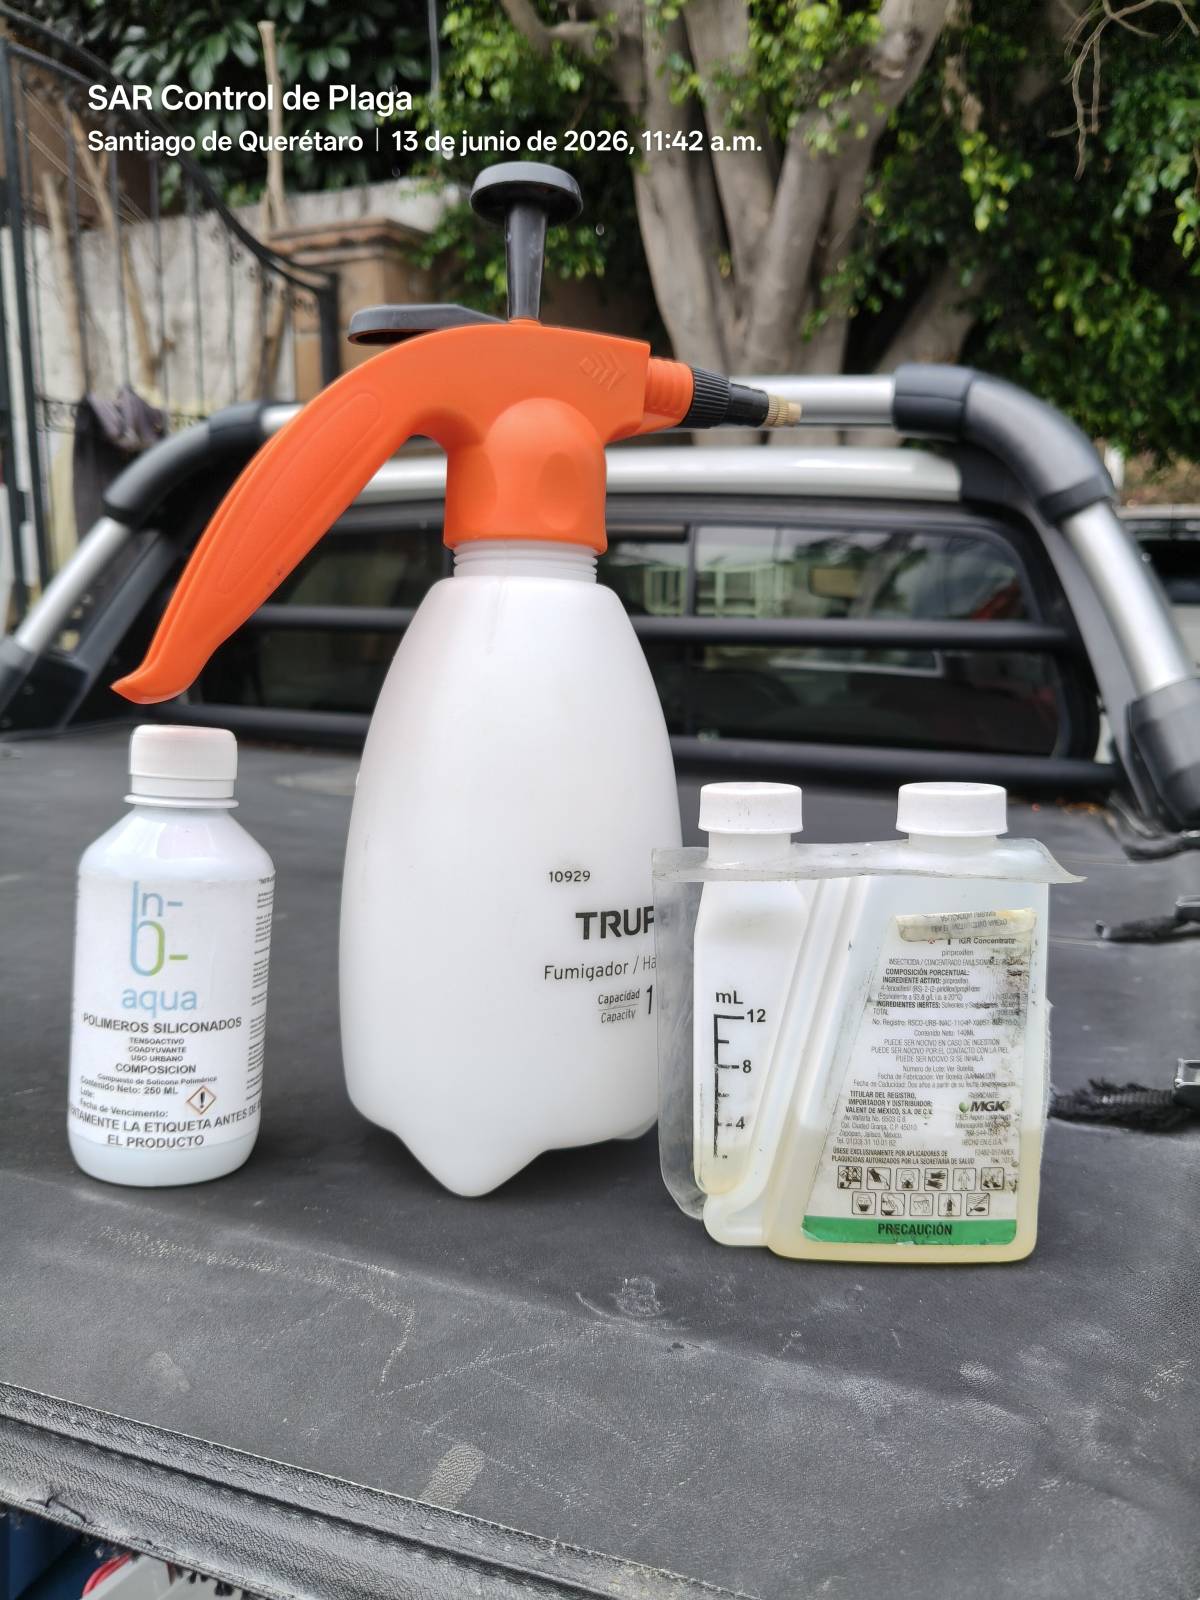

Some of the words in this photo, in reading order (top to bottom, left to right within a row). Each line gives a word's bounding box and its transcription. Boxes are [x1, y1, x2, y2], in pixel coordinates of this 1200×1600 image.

[549, 870, 590, 882] 10929
[544, 961, 629, 982] Fumigador
[885, 967, 928, 975] COMPOSICIÓN
[882, 976, 919, 984] INGREDIENTE
[121, 988, 197, 1019] aqua
[598, 988, 641, 1005] Capacidad
[715, 990, 744, 1004] mL
[873, 1007, 888, 1015] TOTAL
[876, 1000, 916, 1008] INGREDIENTES
[600, 1008, 636, 1024] Capacity
[746, 1009, 766, 1023] 12
[83, 1013, 149, 1033] POLIMEROS
[153, 1016, 242, 1034] SILICONADOS
[129, 1037, 184, 1045] TENSOACTIVO
[131, 1054, 147, 1062] USO
[115, 1063, 197, 1074] COMPOSICION
[742, 1059, 752, 1073] 8
[81, 1075, 115, 1092] Contenido
[117, 1085, 142, 1094] Neto:
[143, 1086, 160, 1094] 250
[850, 1090, 873, 1098] TITULAR
[99, 1104, 109, 1113] de
[848, 1098, 886, 1107] IMPORTADOR
[970, 1101, 1006, 1112] MGK
[123, 1120, 140, 1132] LA
[144, 1119, 212, 1133] ETIQUETA
[214, 1109, 248, 1128] ANTES
[735, 1116, 745, 1130] 4
[108, 1134, 123, 1146] EL
[126, 1135, 205, 1148] PRODUCTO
[878, 1221, 952, 1236] PRECAUCIÓN
